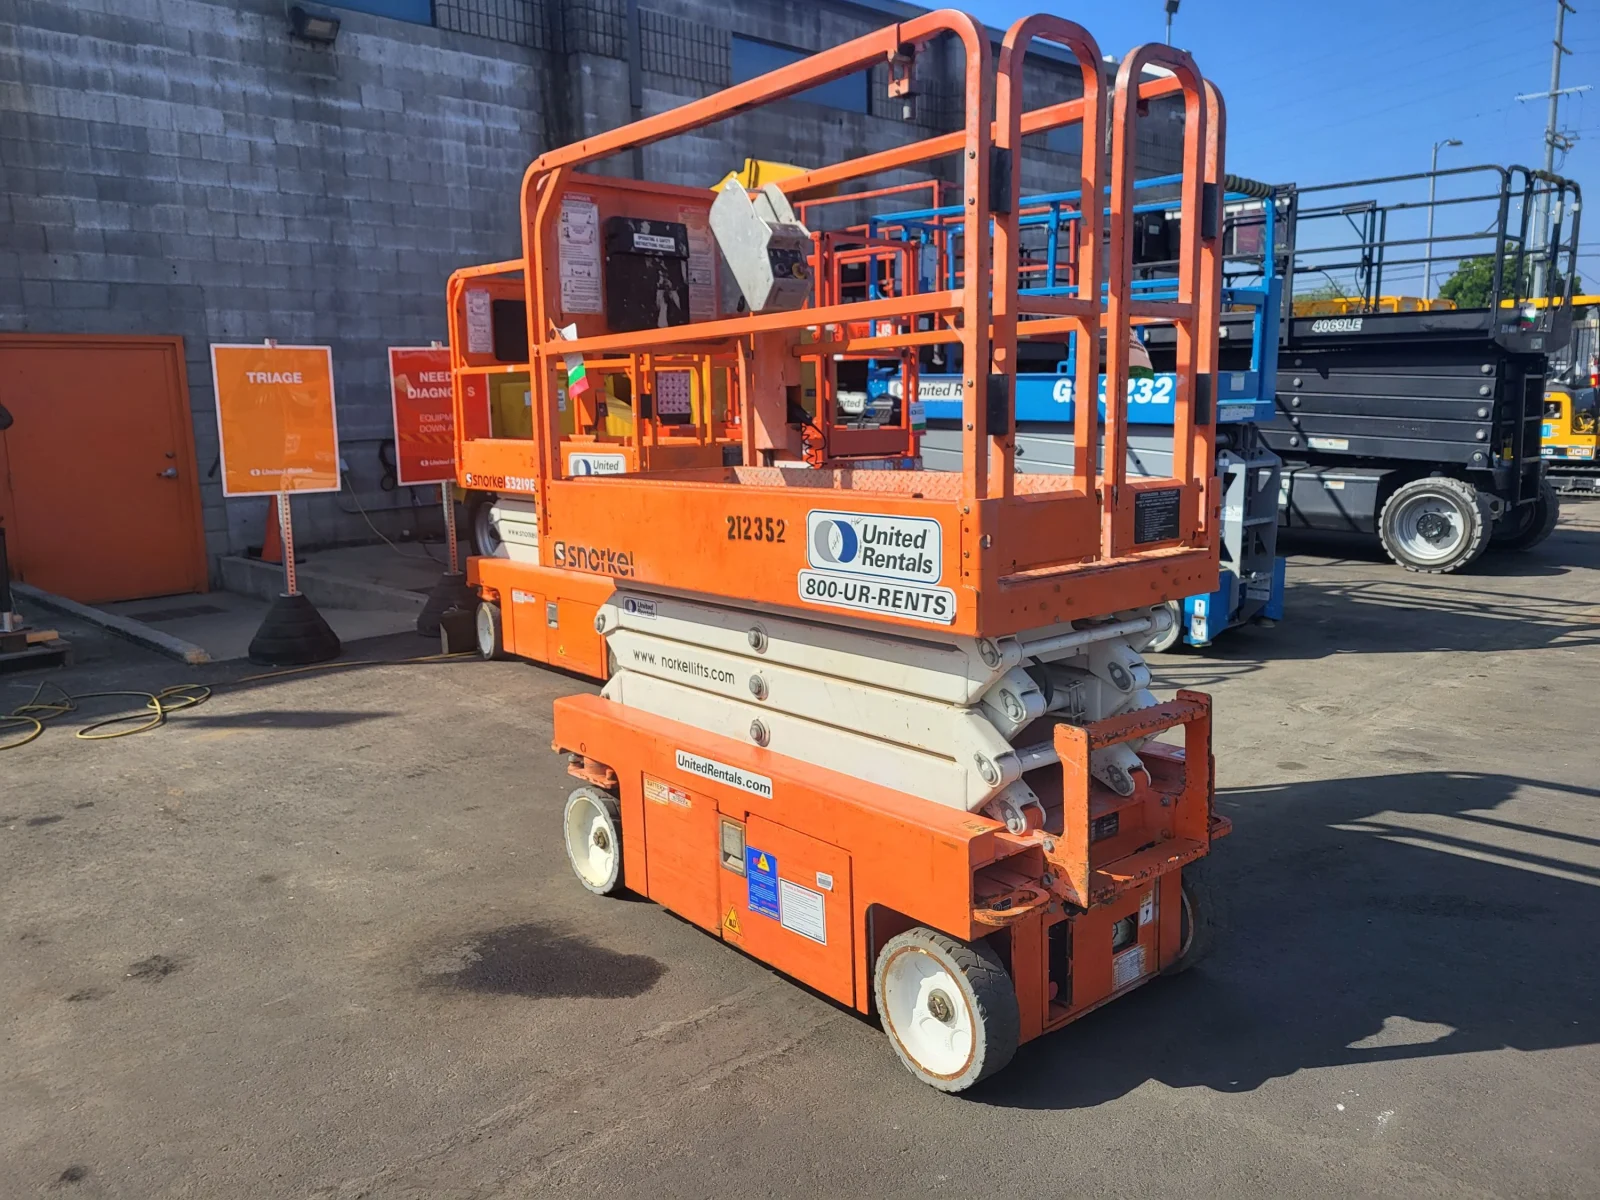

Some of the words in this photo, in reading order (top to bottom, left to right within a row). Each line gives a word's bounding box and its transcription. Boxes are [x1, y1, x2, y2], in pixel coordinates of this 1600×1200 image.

[1311, 318, 1362, 333] 4069LE
[246, 371, 303, 384] TRIAGE
[419, 371, 452, 383] NEED
[917, 381, 950, 396] nited
[593, 460, 619, 470] United
[473, 474, 505, 488] snorkel
[727, 515, 785, 543] 212352
[862, 523, 927, 549] United
[568, 545, 634, 577] snorkel
[861, 546, 933, 574] Rentals
[805, 578, 947, 616] 800-UR-RENTS
[677, 754, 771, 795] UnitedRentals.com
